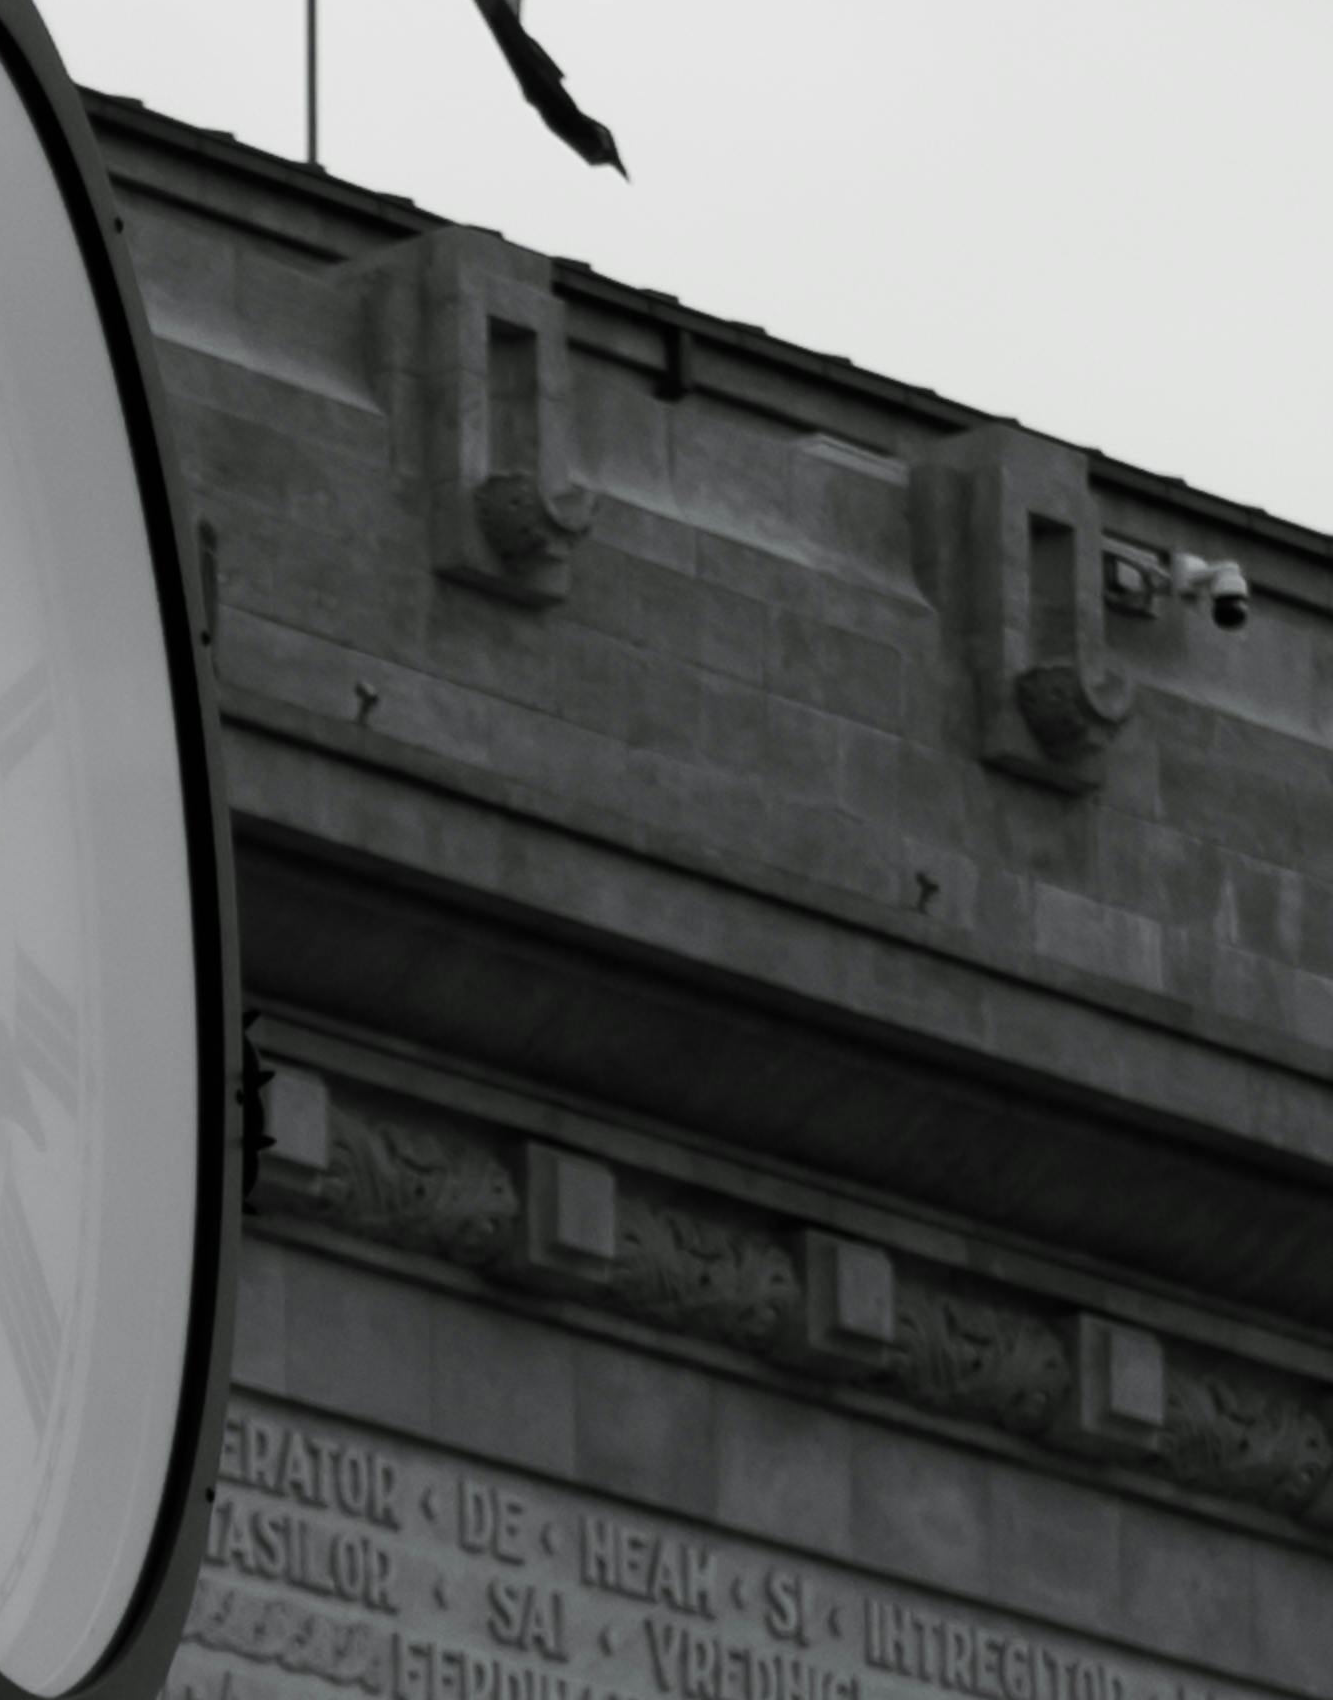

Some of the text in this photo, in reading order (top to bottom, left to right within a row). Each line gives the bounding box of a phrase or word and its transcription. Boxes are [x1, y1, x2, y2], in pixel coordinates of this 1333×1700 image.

[458, 1478, 525, 1567] DE
[764, 1570, 812, 1648] SI
[486, 1581, 569, 1662] SAI
